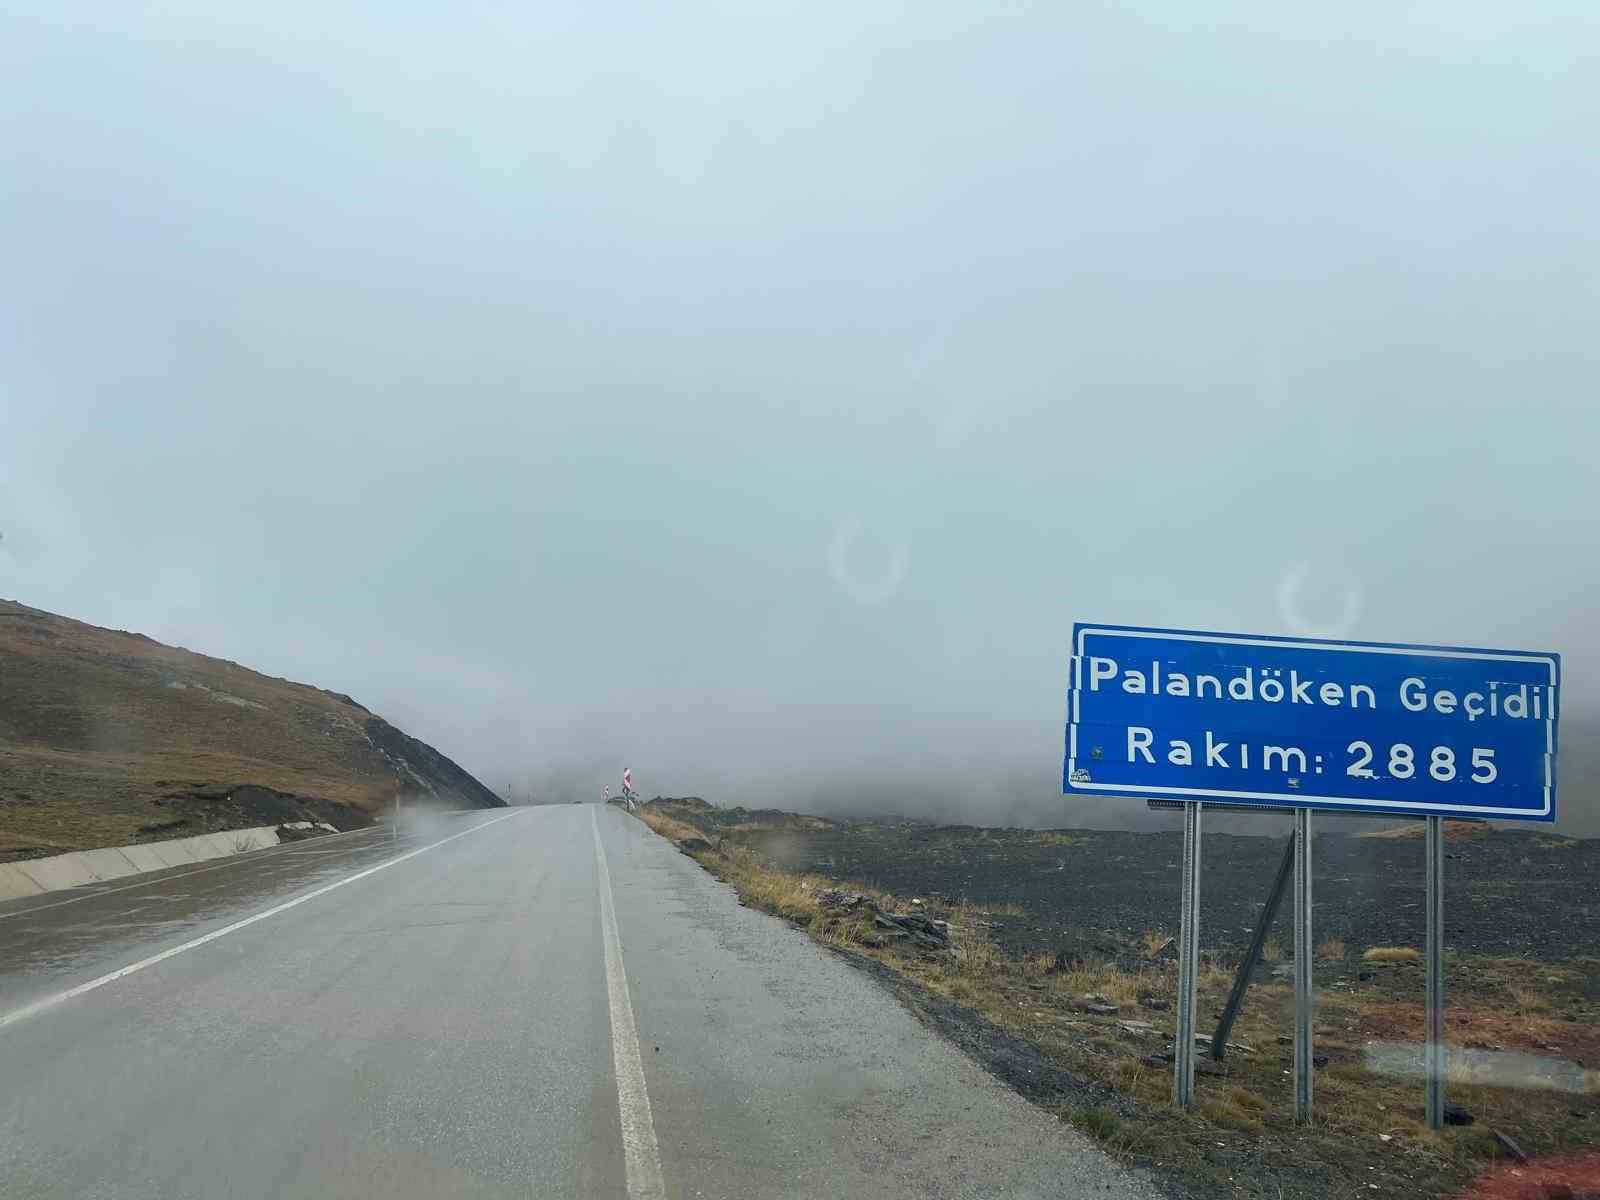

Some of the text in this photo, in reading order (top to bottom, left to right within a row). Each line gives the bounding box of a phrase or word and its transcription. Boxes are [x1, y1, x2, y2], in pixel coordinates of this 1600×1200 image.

[1089, 656, 1541, 721] Palandöken Geçidi
[1127, 726, 1498, 784] Rakım: 2885
